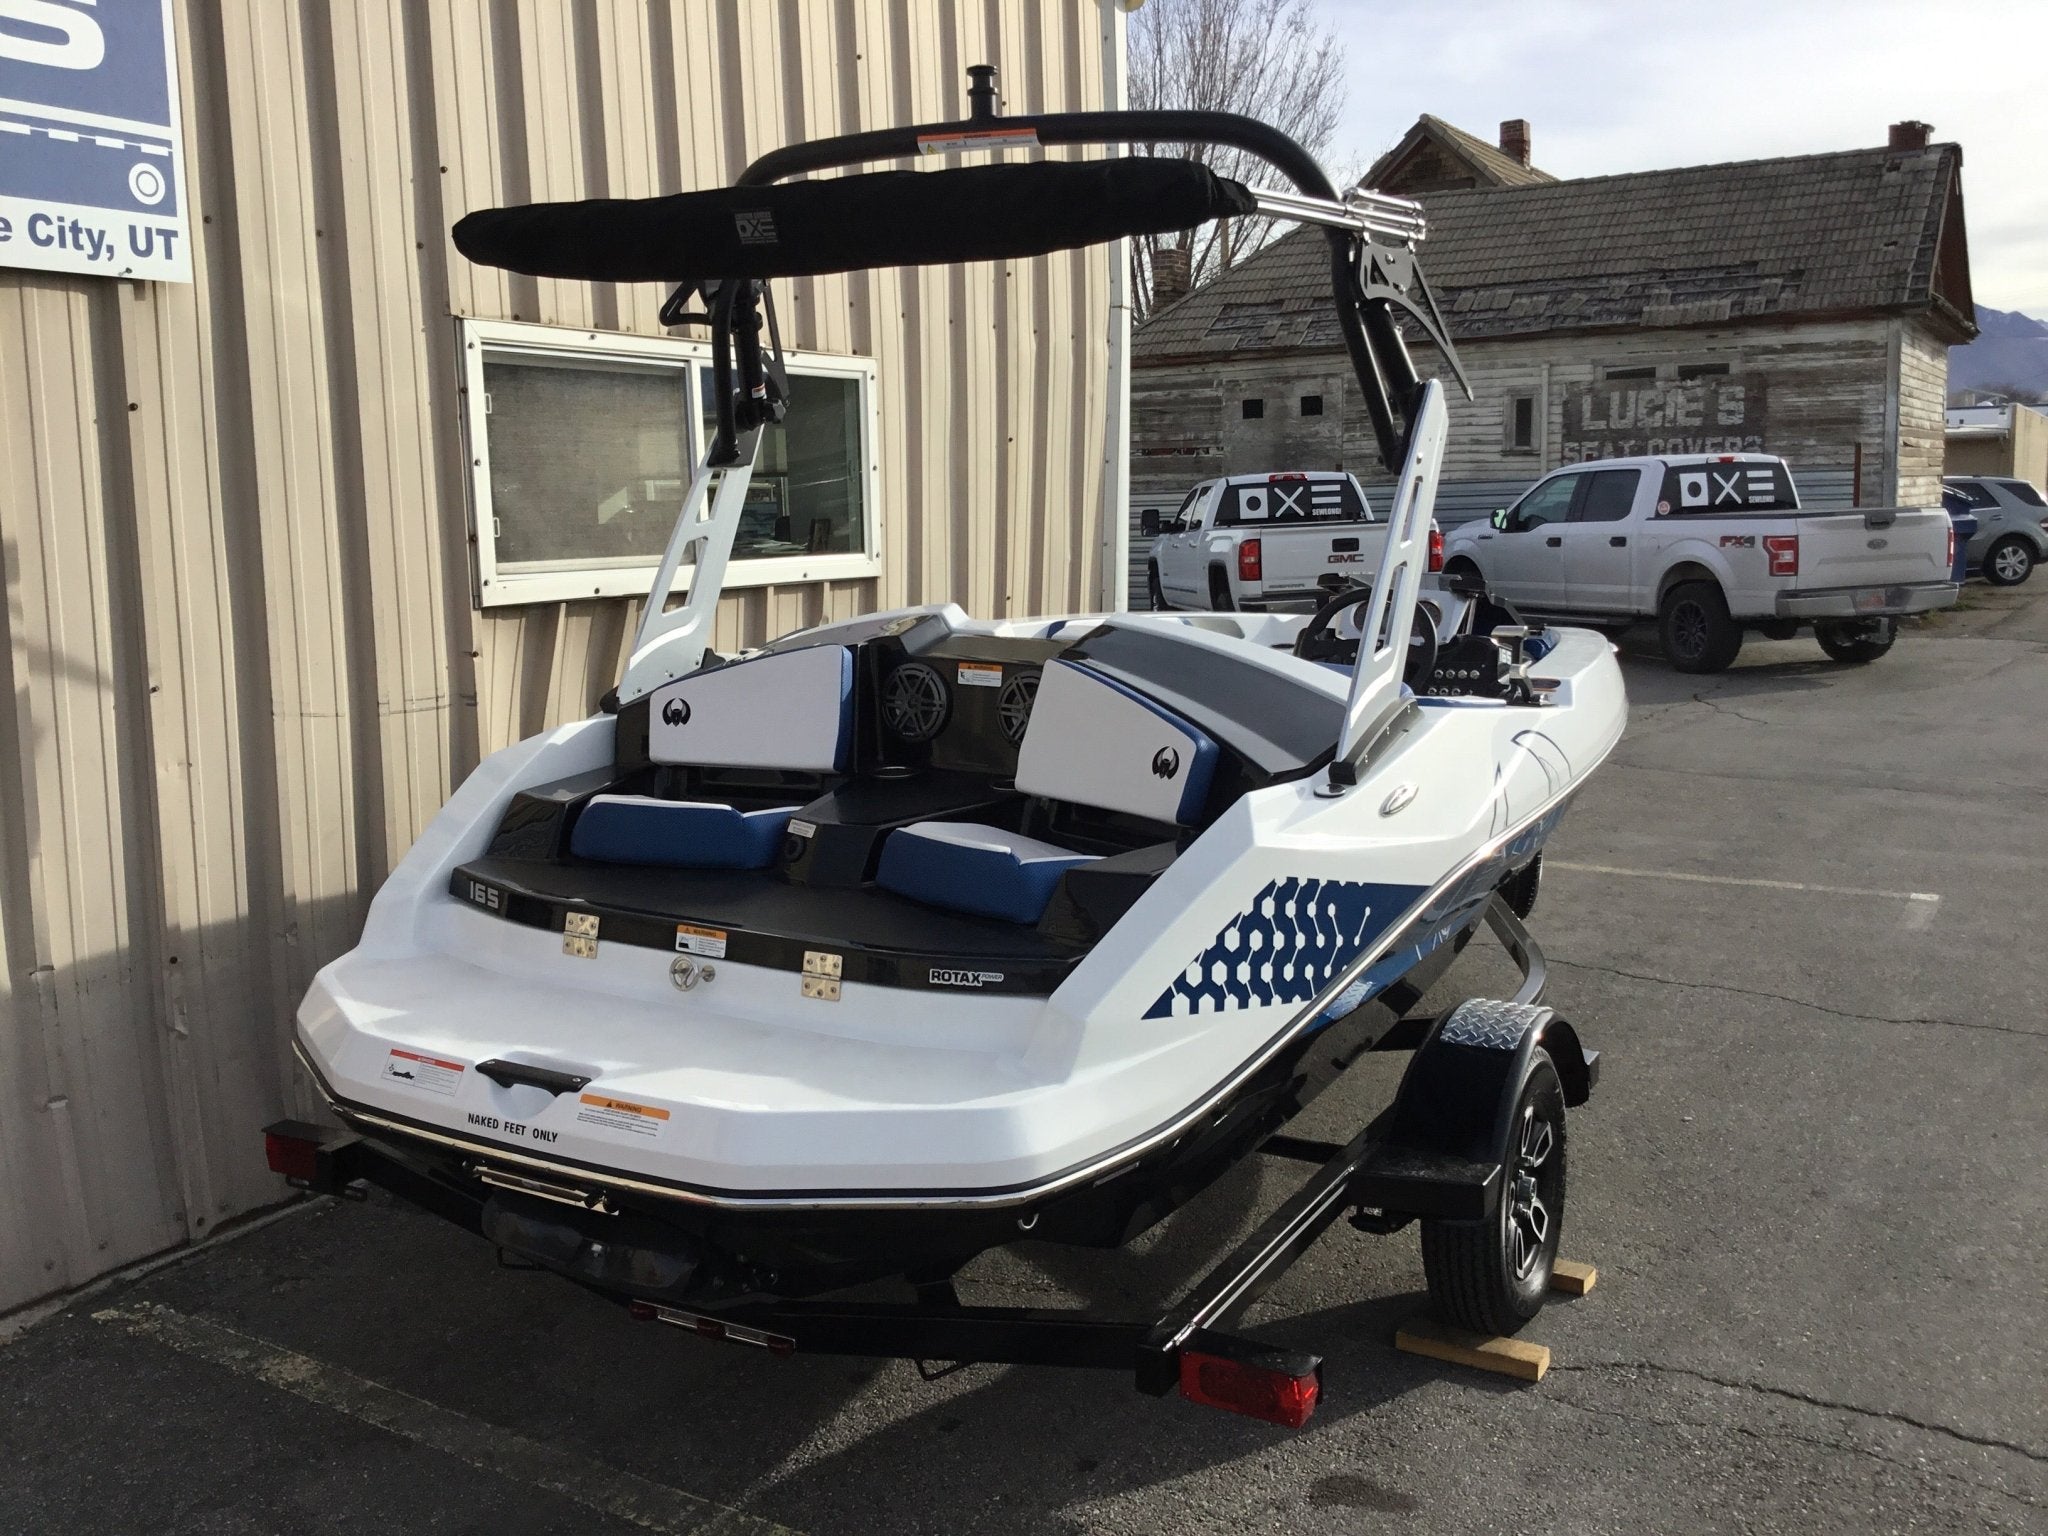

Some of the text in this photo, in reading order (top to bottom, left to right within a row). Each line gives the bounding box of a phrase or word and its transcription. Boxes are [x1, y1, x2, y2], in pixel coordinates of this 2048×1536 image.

[27, 212, 115, 262] City,
[128, 224, 179, 261] UT
[1719, 535, 1756, 548] FX4
[1327, 553, 1364, 564] GMC
[470, 880, 499, 909] 165
[931, 970, 981, 985] ROTAX
[615, 1102, 642, 1113] WARNING
[467, 1112, 558, 1143] NAKED FEET ONLY
